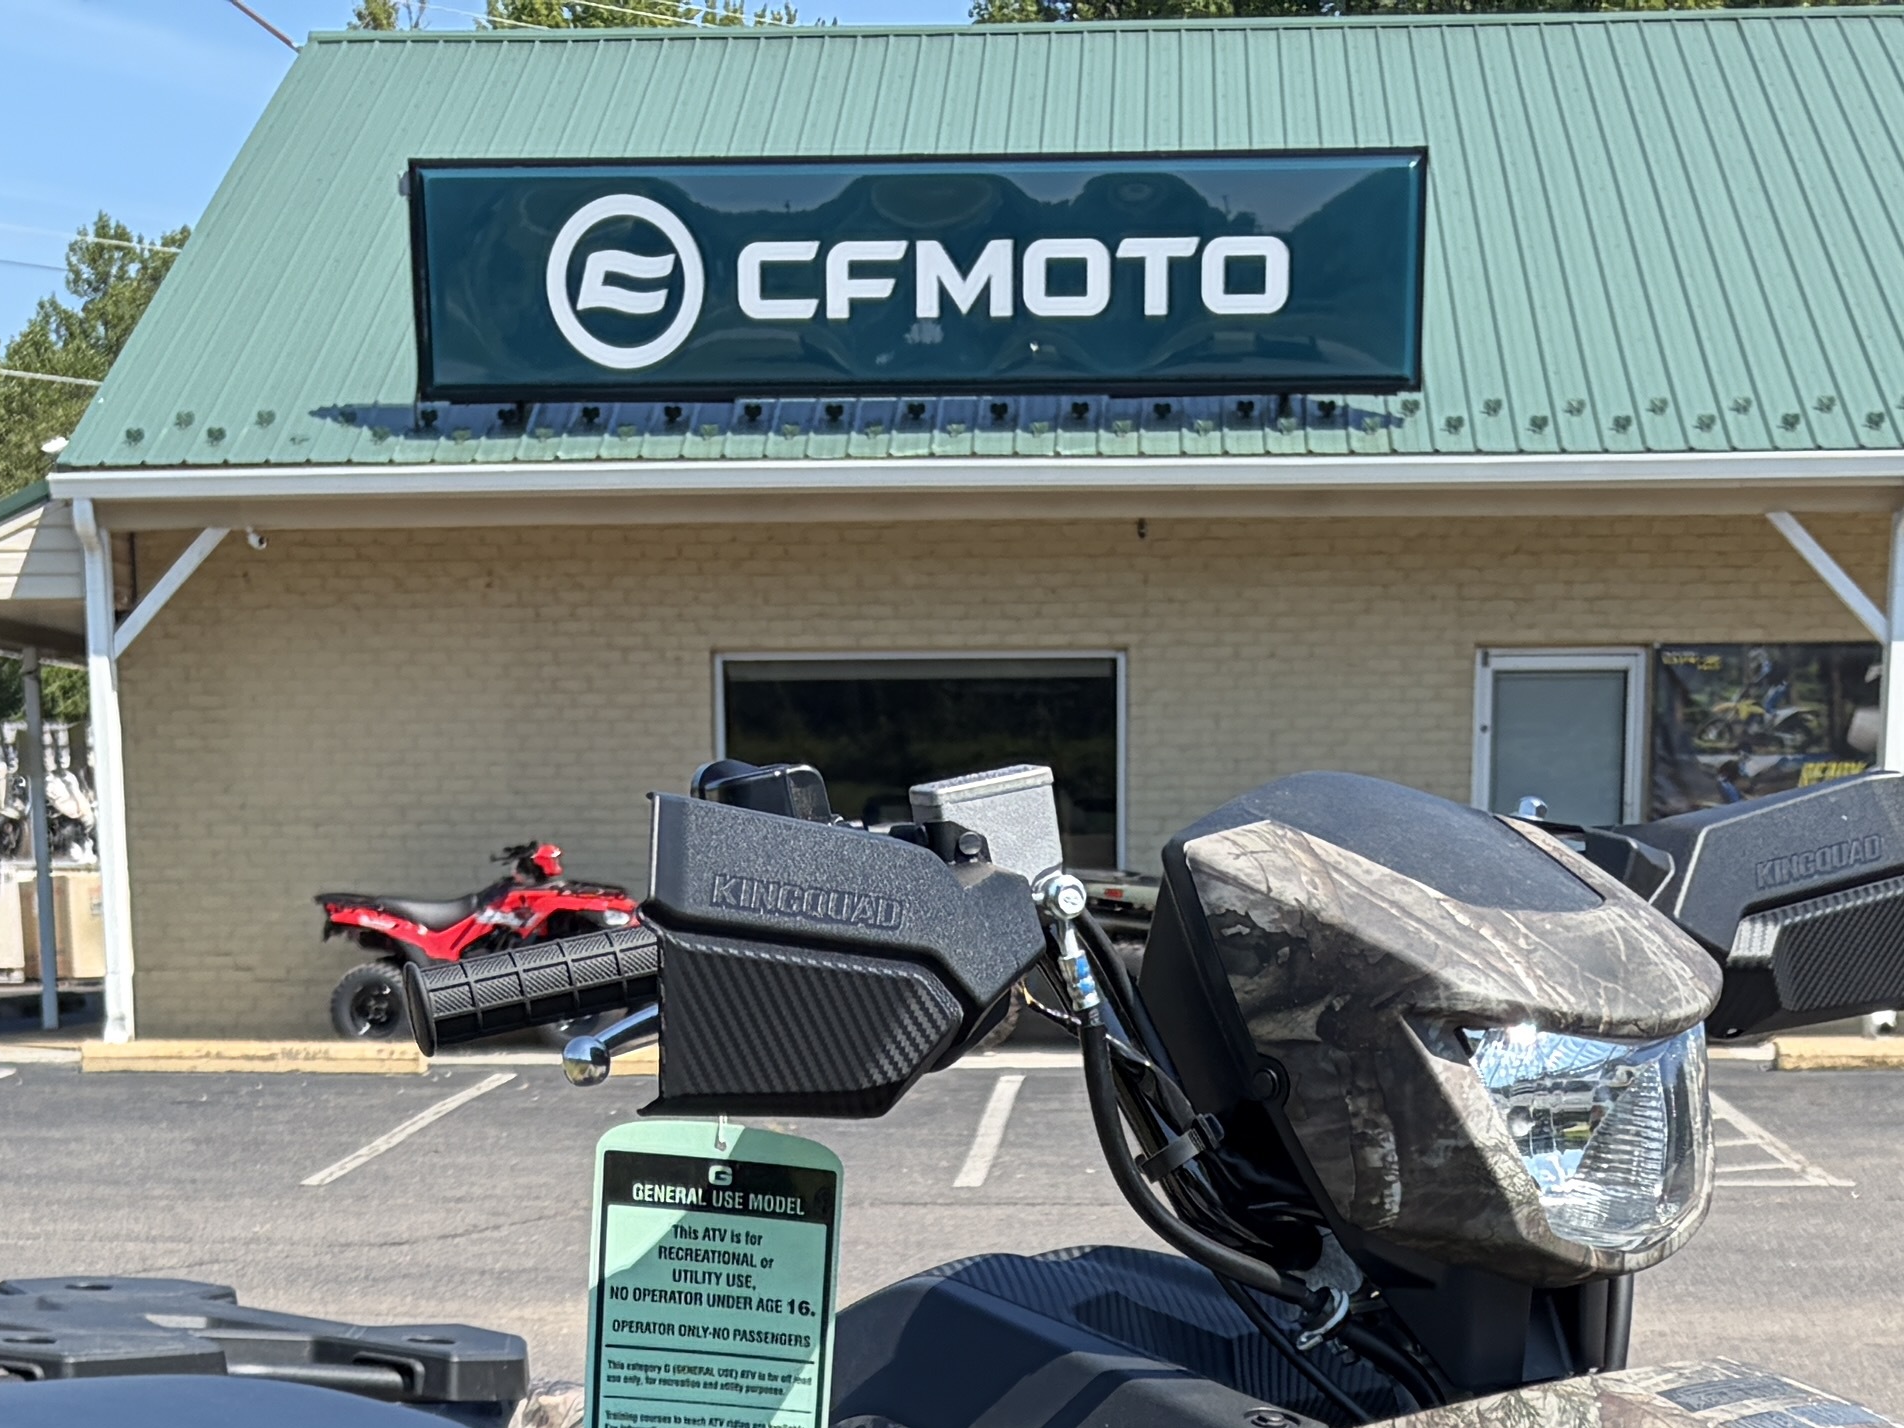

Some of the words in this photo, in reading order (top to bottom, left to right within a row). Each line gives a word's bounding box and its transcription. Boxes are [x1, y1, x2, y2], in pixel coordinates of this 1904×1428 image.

[738, 235, 1290, 319] CFMOTO
[1756, 834, 1883, 890] KINGQUAD
[710, 874, 905, 929] KINGQUAD
[633, 1184, 706, 1205] GENERAL
[712, 1190, 744, 1209] USE
[749, 1193, 805, 1215] MODEL
[673, 1225, 698, 1241] This
[703, 1227, 727, 1243] ATV
[731, 1230, 742, 1244] is
[745, 1231, 762, 1246] for
[659, 1246, 757, 1268] RECREATIONAL
[761, 1257, 774, 1269] or
[673, 1268, 723, 1286] UTILITY
[727, 1273, 756, 1291] USE,
[610, 1286, 628, 1300] NO
[633, 1288, 703, 1306] OPERATOR
[707, 1293, 753, 1310] UNDER
[756, 1298, 782, 1313] AGE
[787, 1299, 816, 1317] 16.
[613, 1320, 675, 1335] OPERATOR
[733, 1329, 810, 1347] PASSENGERS
[607, 1360, 624, 1370] This
[606, 1410, 638, 1424] Training
[640, 1413, 671, 1424] courses
[708, 1417, 724, 1427] ATV
